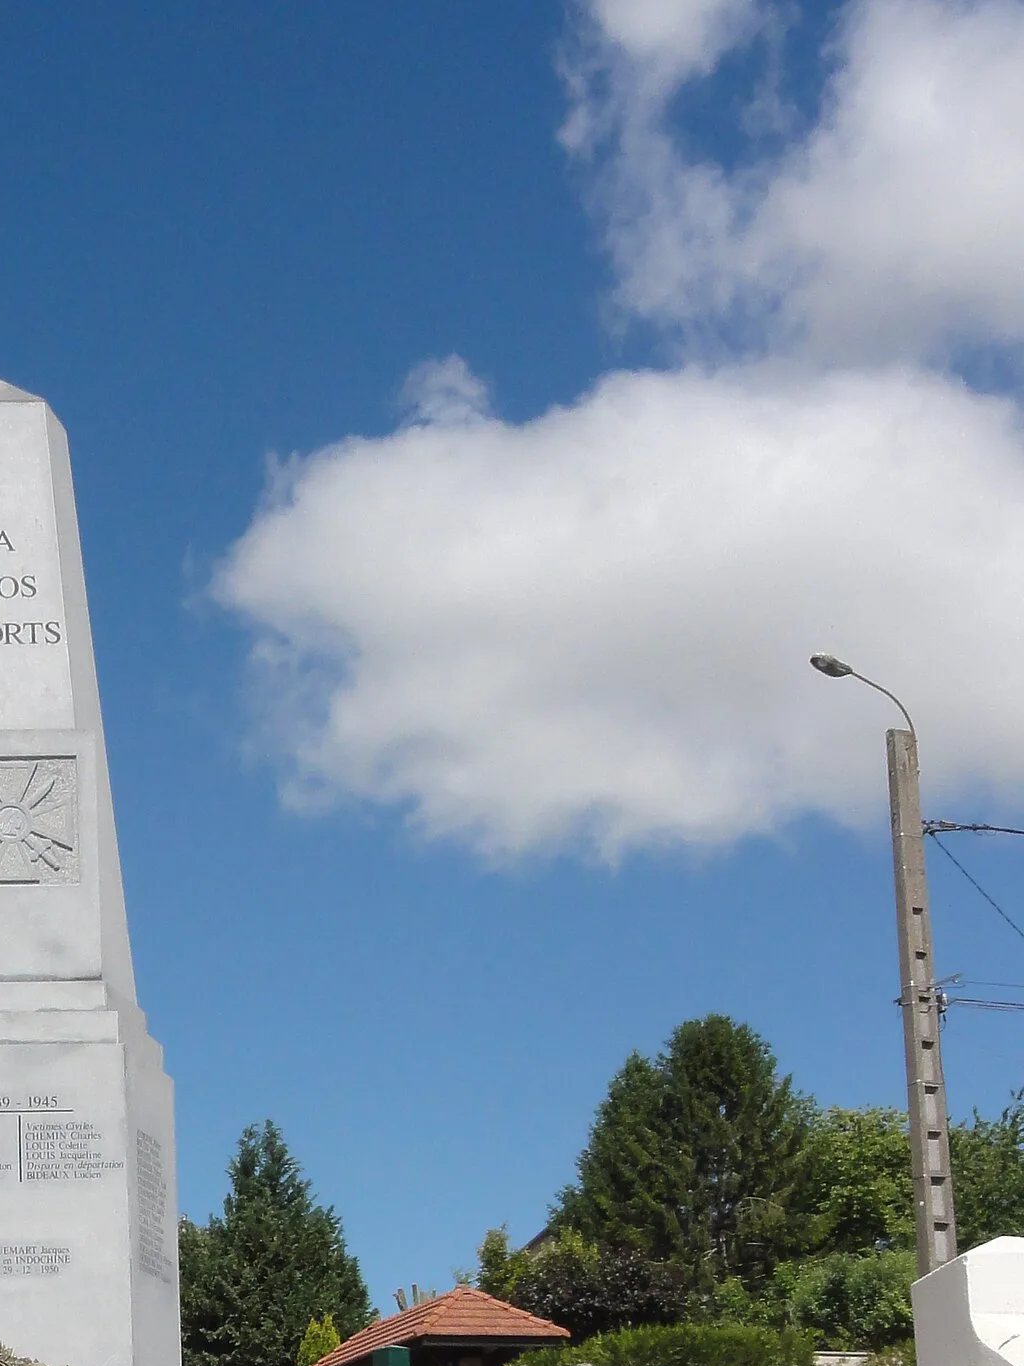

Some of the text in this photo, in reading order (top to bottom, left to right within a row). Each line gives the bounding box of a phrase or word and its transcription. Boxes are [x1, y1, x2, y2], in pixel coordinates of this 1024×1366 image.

[28, 1096, 58, 1108] 1945
[27, 1122, 94, 1131] Victimes Civiles
[25, 1132, 66, 1140] CHEMIN
[26, 1142, 55, 1150] LOUIS
[60, 1151, 102, 1160] Jacqueline
[27, 1162, 60, 1170] Disparu
[78, 1161, 124, 1170] déportation
[27, 1171, 69, 1179] BIDEAUX
[41, 1246, 70, 1255] Jacques
[15, 1256, 70, 1264] INDOCHINE
